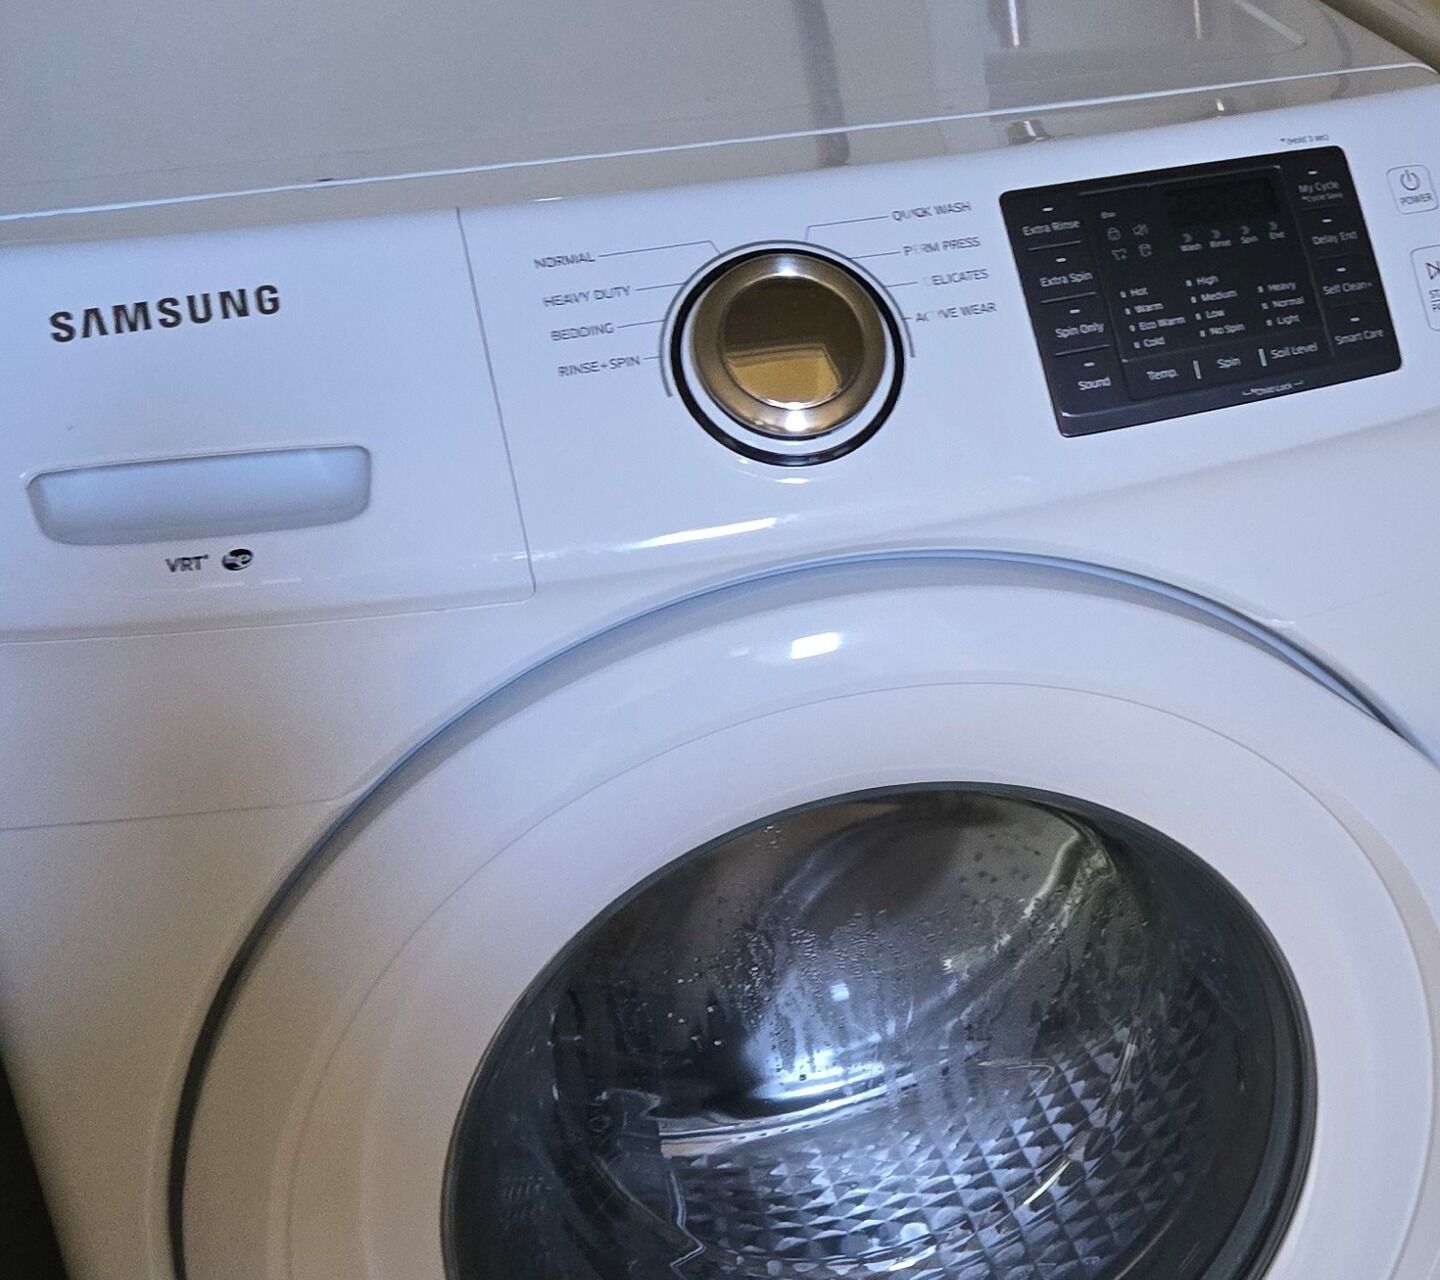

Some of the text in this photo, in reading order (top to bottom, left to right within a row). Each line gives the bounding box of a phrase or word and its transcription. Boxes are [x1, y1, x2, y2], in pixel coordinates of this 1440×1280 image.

[1400, 193, 1433, 205] POWER
[892, 201, 972, 222] QUICK WASH
[1022, 220, 1081, 236] Extra Rinse
[943, 237, 981, 250] PRESS
[1312, 230, 1358, 246] Delay End
[533, 252, 596, 268] NORMAL
[922, 269, 989, 286] ELICATES
[1039, 271, 1094, 287] Extra Spin
[1196, 275, 1219, 287] High
[1267, 282, 1297, 293] Heavy
[543, 285, 631, 307] HEAVY DUTY
[1200, 290, 1238, 302] Medium
[1272, 296, 1305, 308] Normal
[49, 284, 280, 343] SAMSUNG
[960, 302, 997, 316] WEAR
[1134, 303, 1165, 314] Warm
[1205, 309, 1226, 319] Low
[1276, 314, 1301, 326] Light
[550, 322, 614, 341] BEDDING
[1055, 322, 1105, 339] Spin Only
[1334, 328, 1385, 346] Smart Care
[1142, 336, 1166, 348] Cold
[1270, 342, 1319, 360] Soil Level
[1216, 357, 1242, 370] Spin
[1077, 377, 1112, 391] Sound
